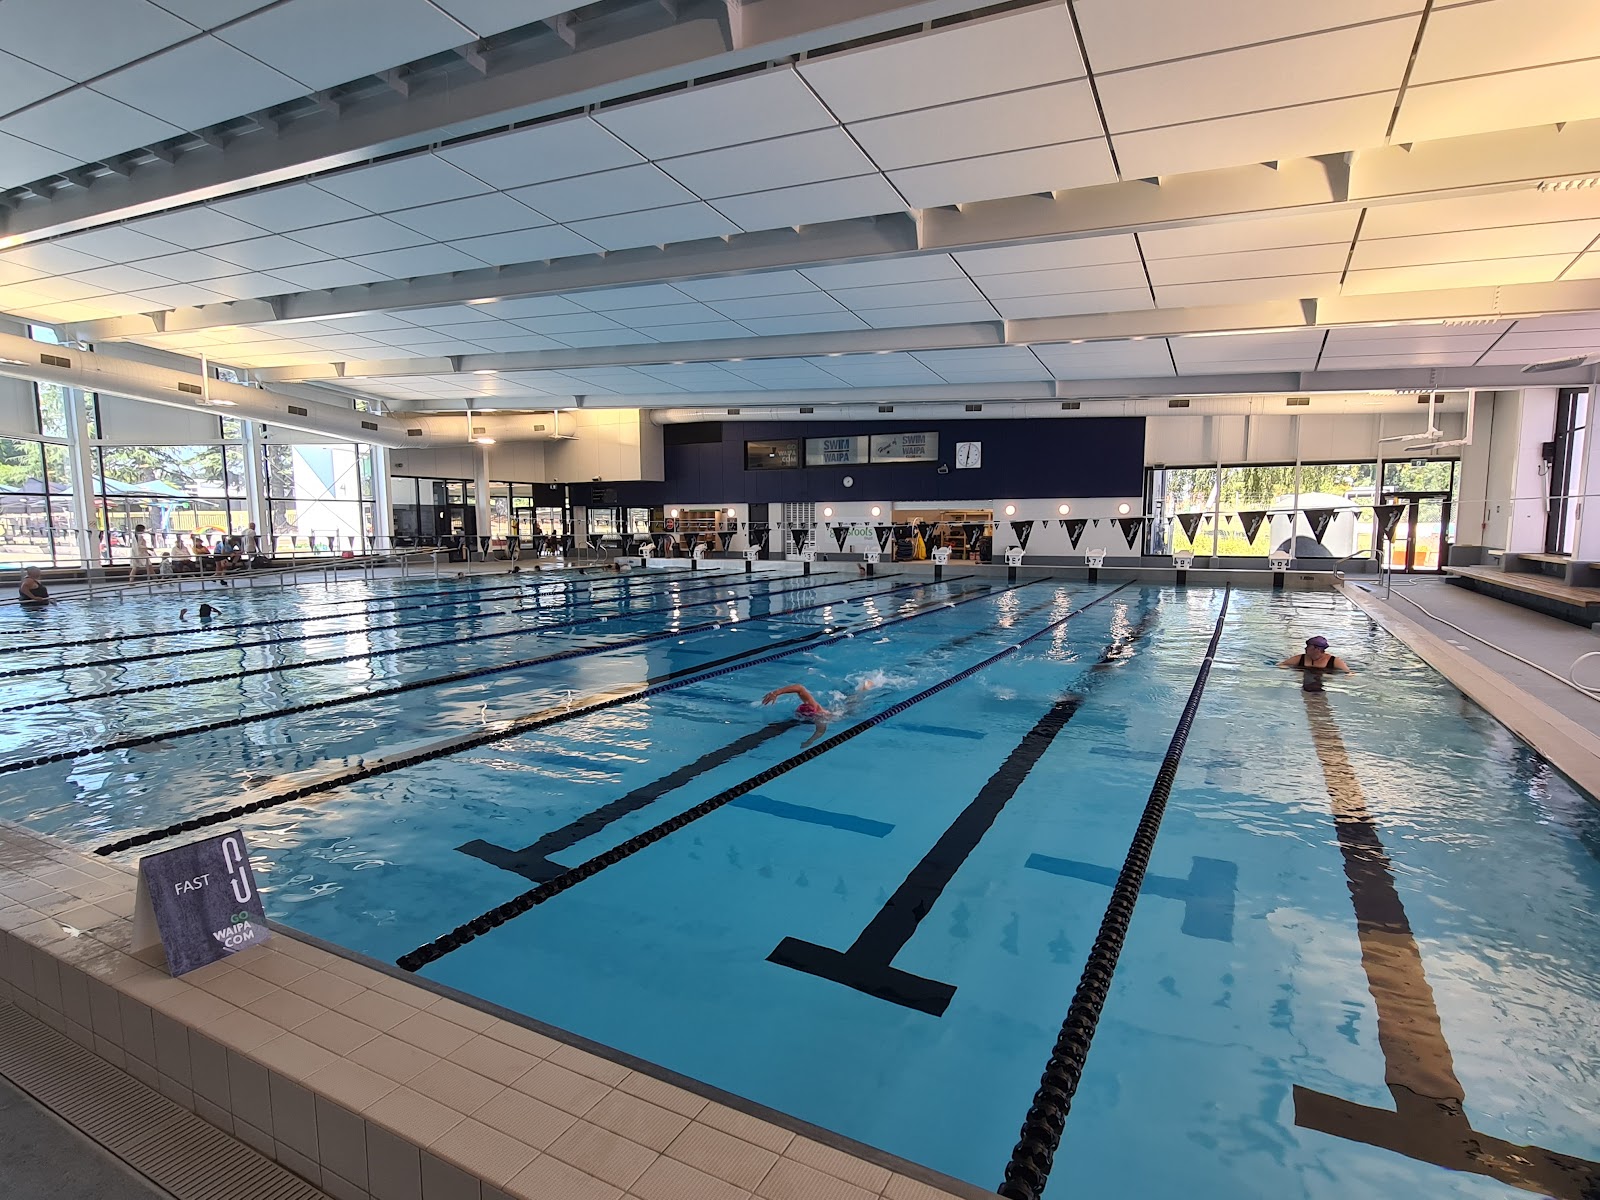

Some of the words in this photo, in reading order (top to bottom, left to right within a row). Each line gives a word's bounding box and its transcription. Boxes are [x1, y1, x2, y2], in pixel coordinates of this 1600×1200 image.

[823, 440, 849, 450] SWIM
[902, 435, 925, 444] SWIM
[902, 447, 925, 455] WAIPA
[823, 453, 849, 462] WAIPA
[174, 874, 210, 895] FAST
[231, 911, 248, 923] GO
[213, 921, 251, 940] WAIPA
[225, 930, 254, 947] COM
